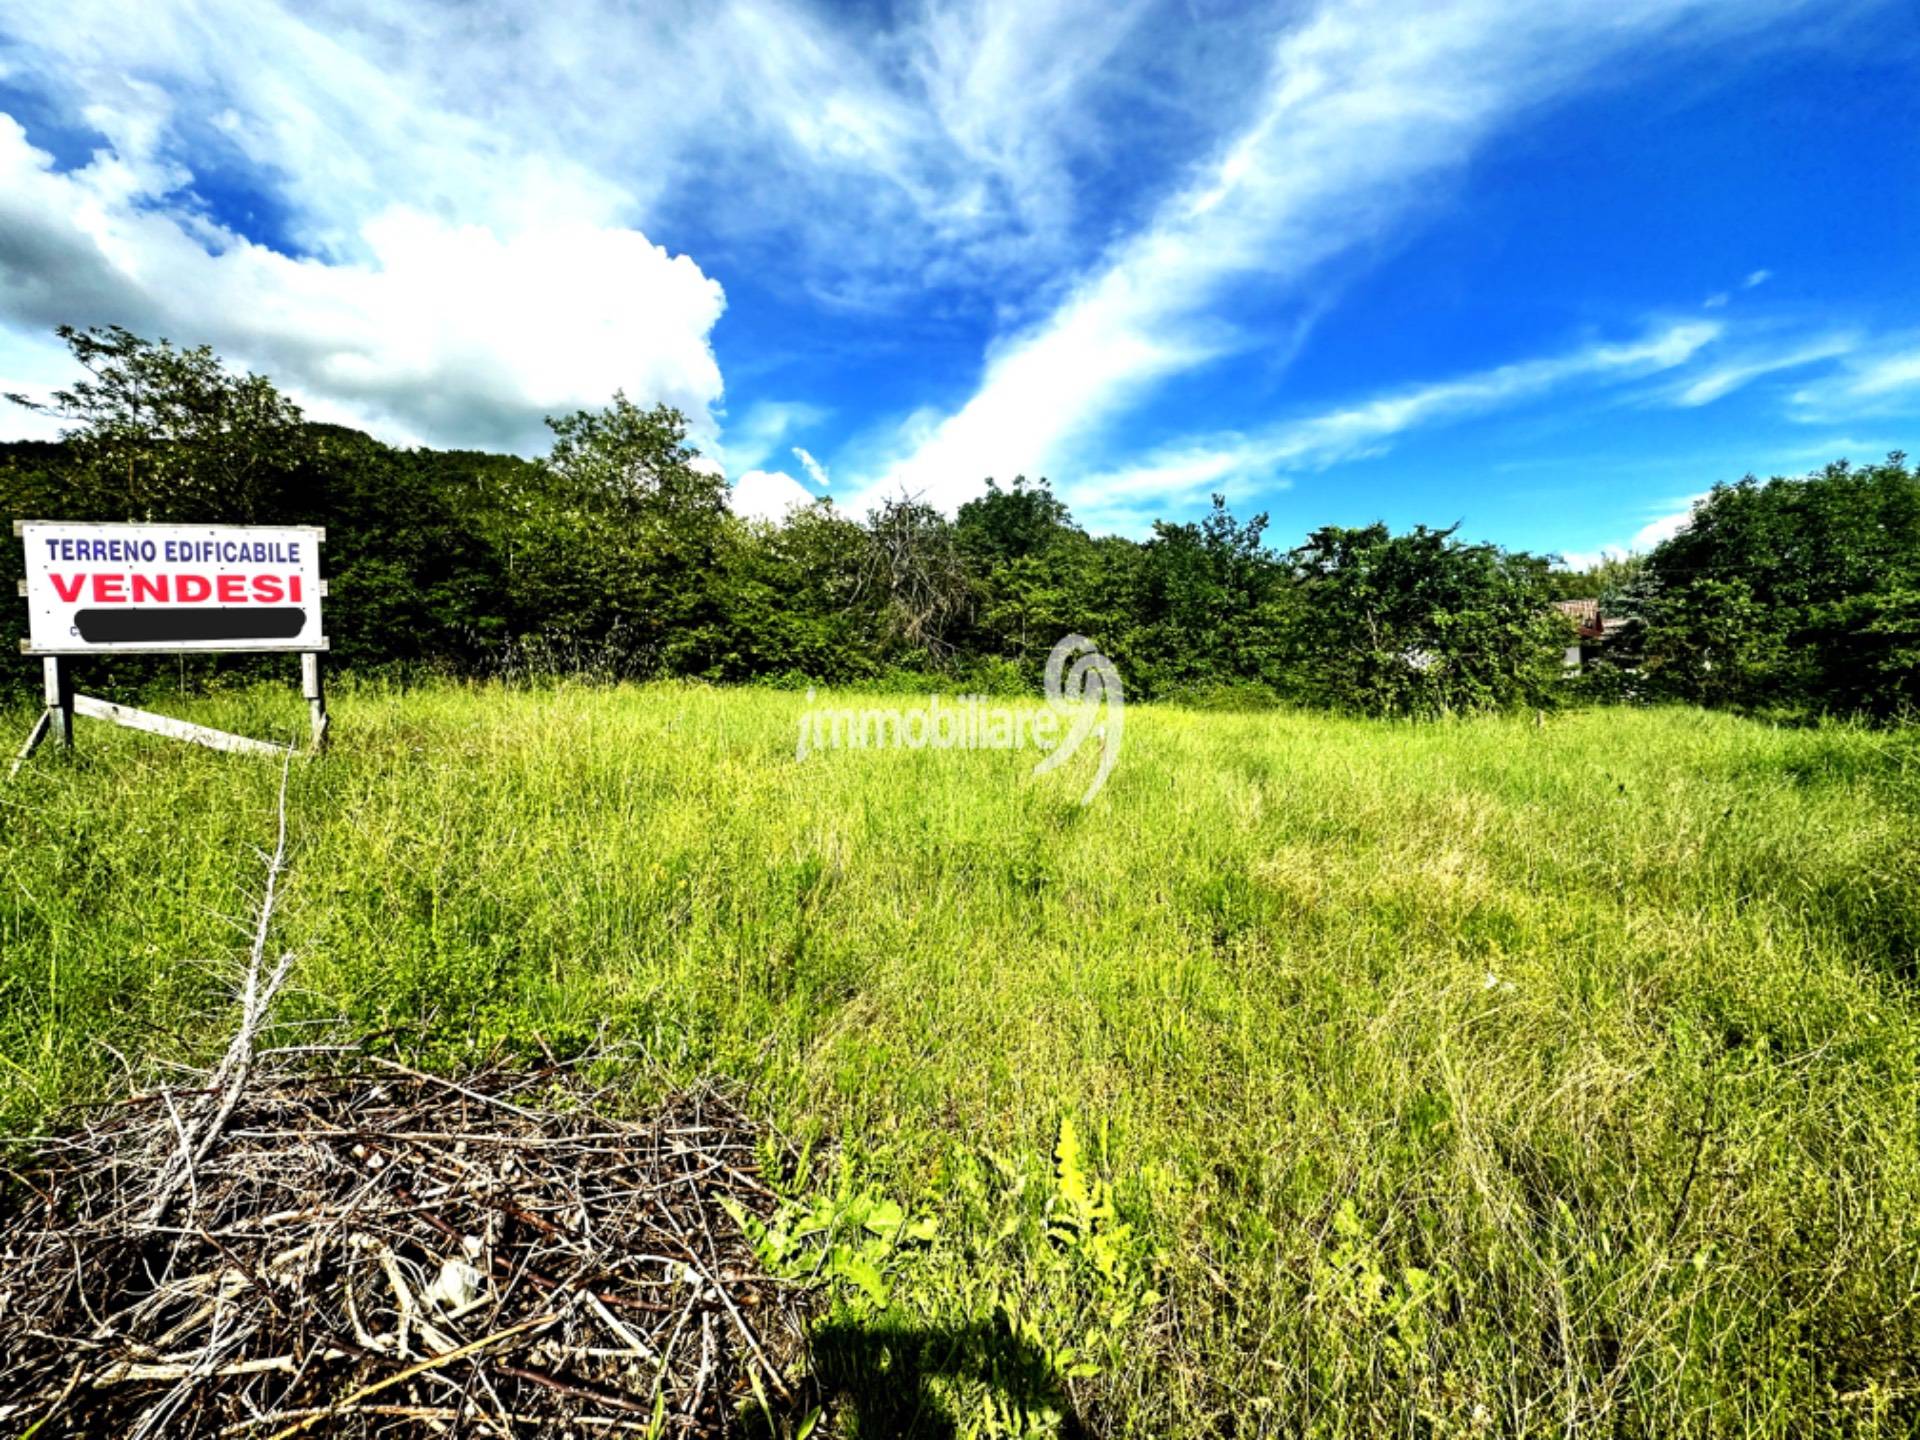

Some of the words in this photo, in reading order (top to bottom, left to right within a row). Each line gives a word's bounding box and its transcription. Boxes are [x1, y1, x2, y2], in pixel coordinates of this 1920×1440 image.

[46, 539, 156, 562] TERRENO
[165, 541, 300, 563] EDIFICABILE
[48, 573, 302, 603] VENDESI
